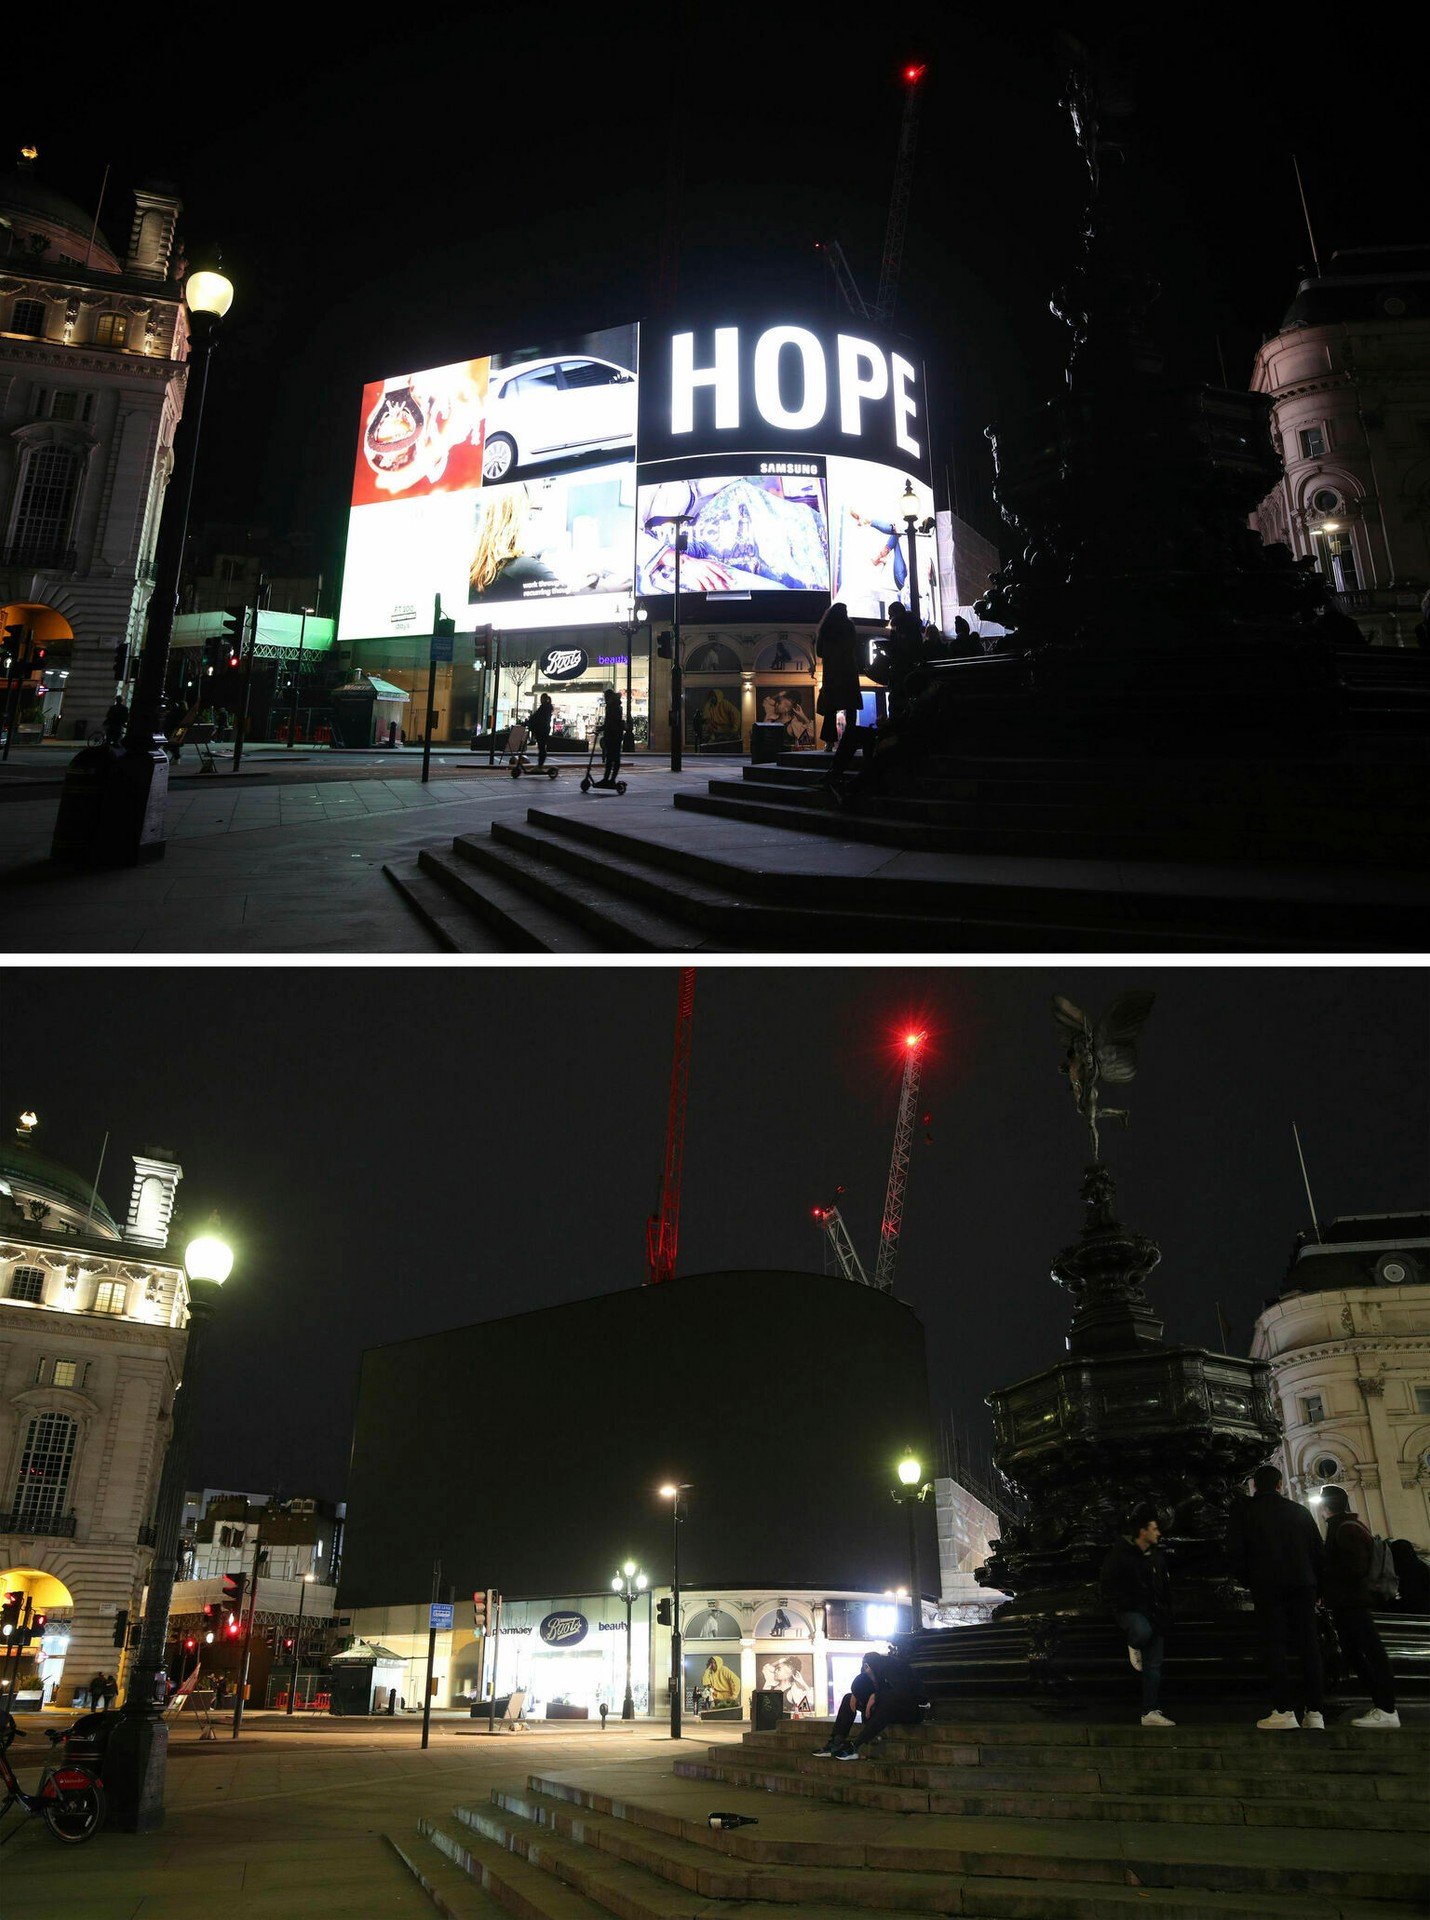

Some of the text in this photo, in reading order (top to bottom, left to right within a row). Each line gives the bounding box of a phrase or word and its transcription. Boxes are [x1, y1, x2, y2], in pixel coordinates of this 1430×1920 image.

[671, 325, 920, 459] HOPE
[759, 462, 818, 475] SAMSUNG
[522, 581, 538, 589] work
[523, 588, 551, 597] recurring
[543, 649, 582, 675] Boots
[543, 1616, 582, 1641] Boots
[598, 1621, 629, 1632] beauty
